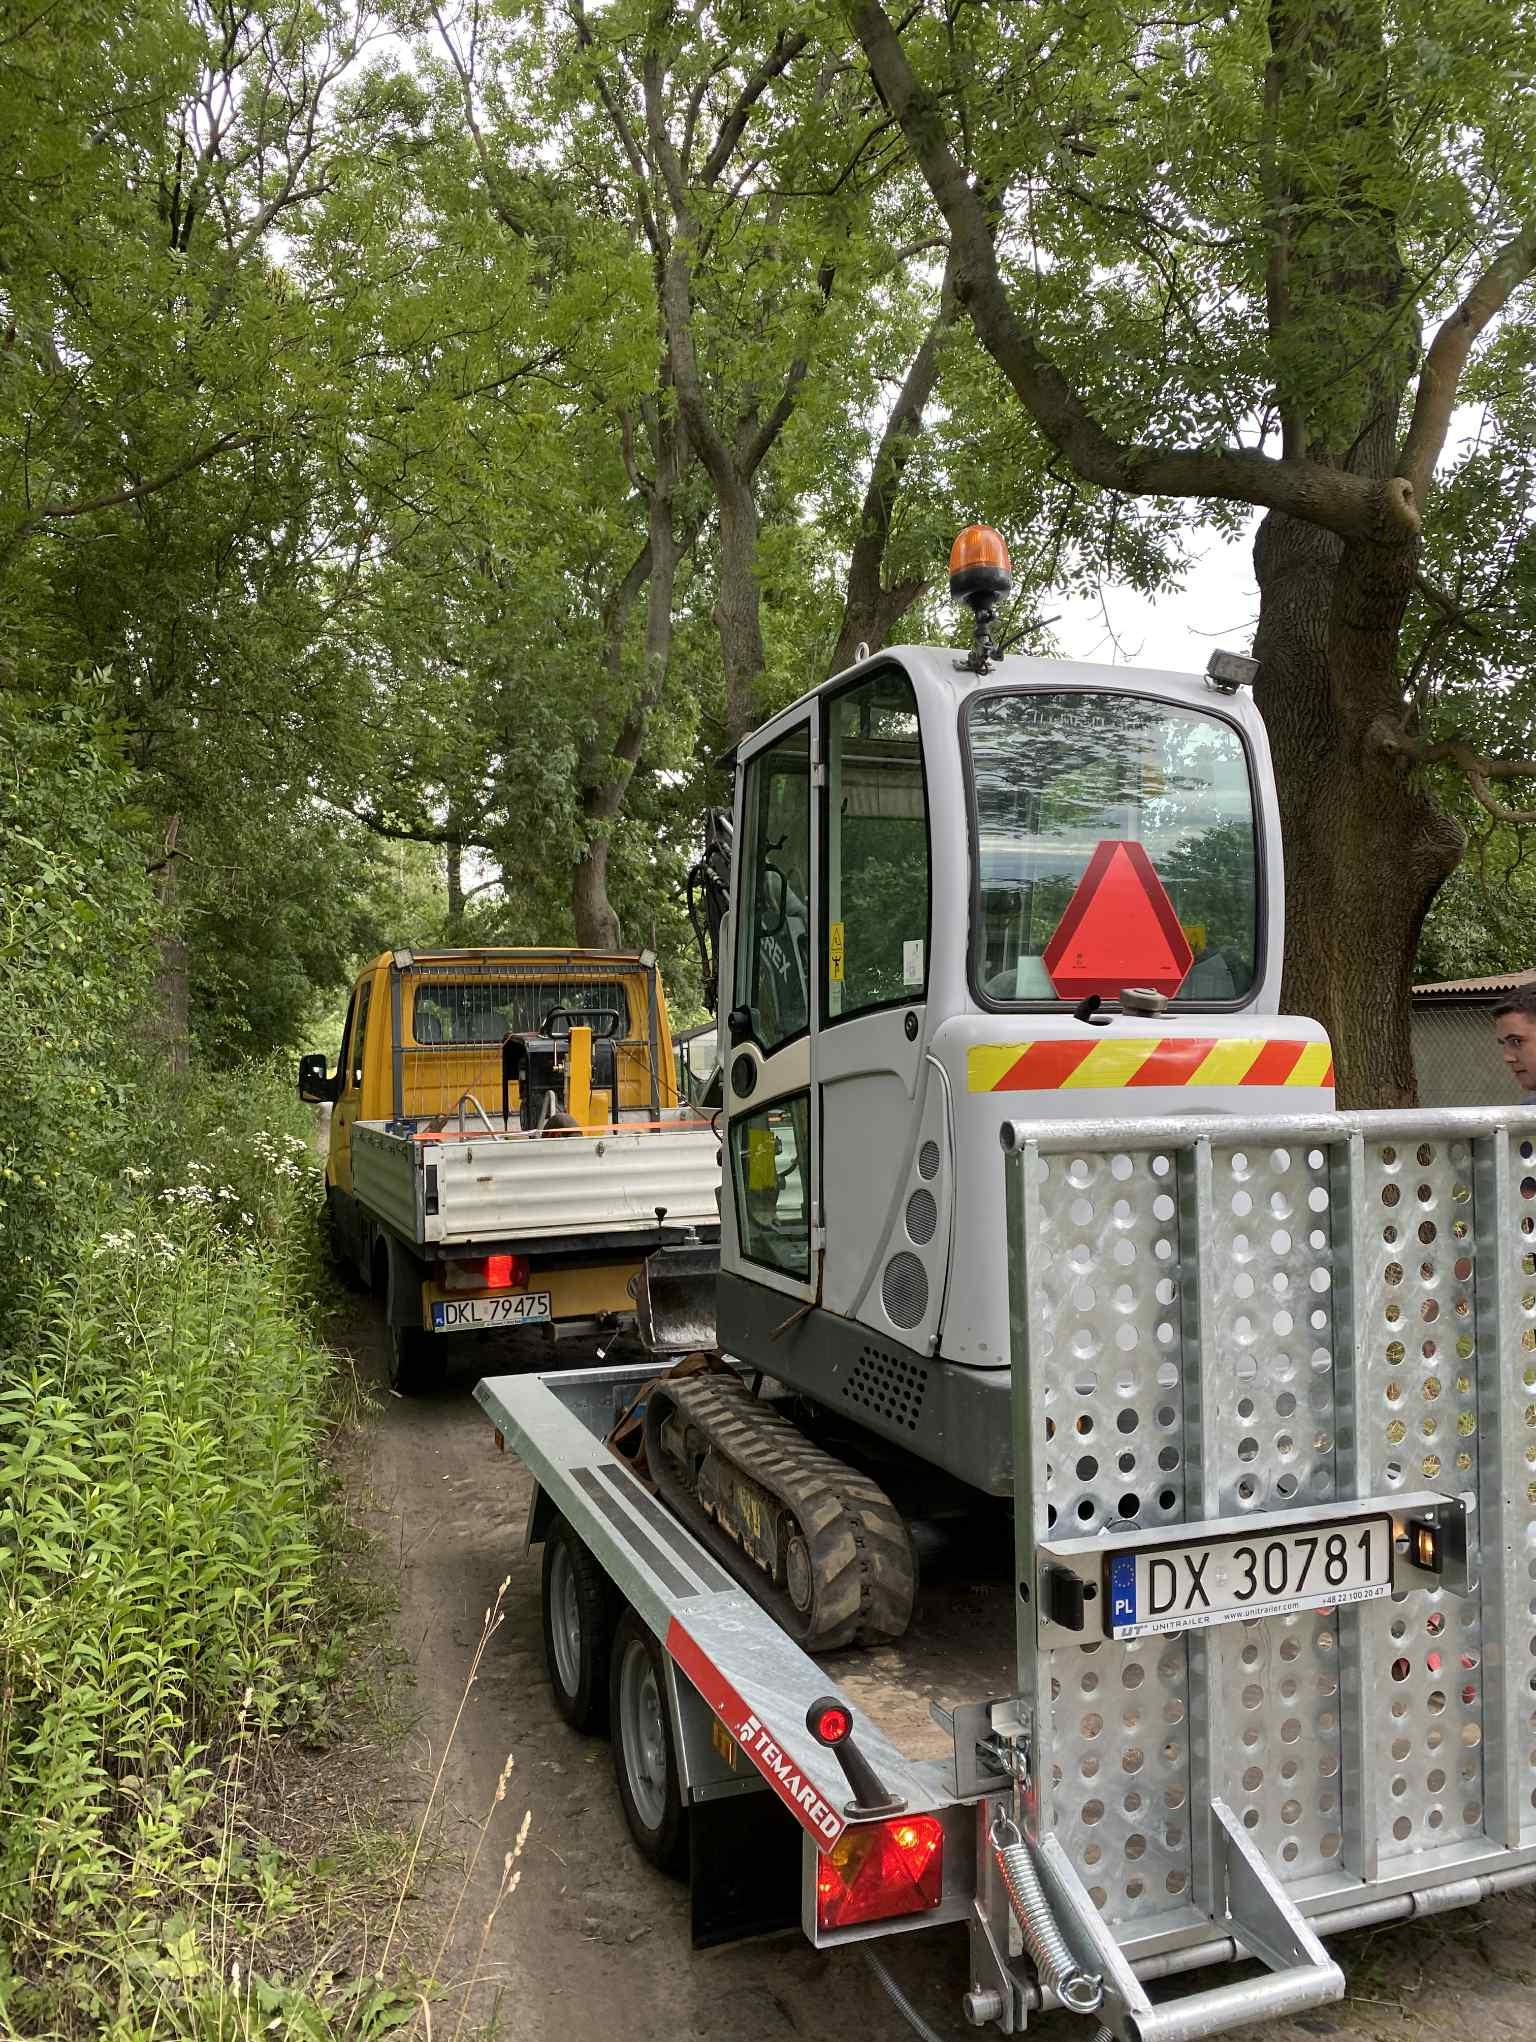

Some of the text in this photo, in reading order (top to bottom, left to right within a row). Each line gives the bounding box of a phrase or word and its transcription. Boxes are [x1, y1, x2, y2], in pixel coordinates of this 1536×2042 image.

[445, 1302, 483, 1325] DKL
[489, 1296, 548, 1320] 79475
[1149, 1529, 1371, 1615] DX 30781
[1322, 1595, 1336, 1604] +48
[1338, 1594, 1347, 1602] 22
[1349, 1591, 1363, 1600] 100
[1364, 1590, 1373, 1598] 20
[1115, 1599, 1133, 1616] PL
[1223, 1601, 1299, 1620] www.unitrailer.com
[1152, 1616, 1210, 1632] UNITRAILER
[754, 1731, 841, 1838] TEMARED
